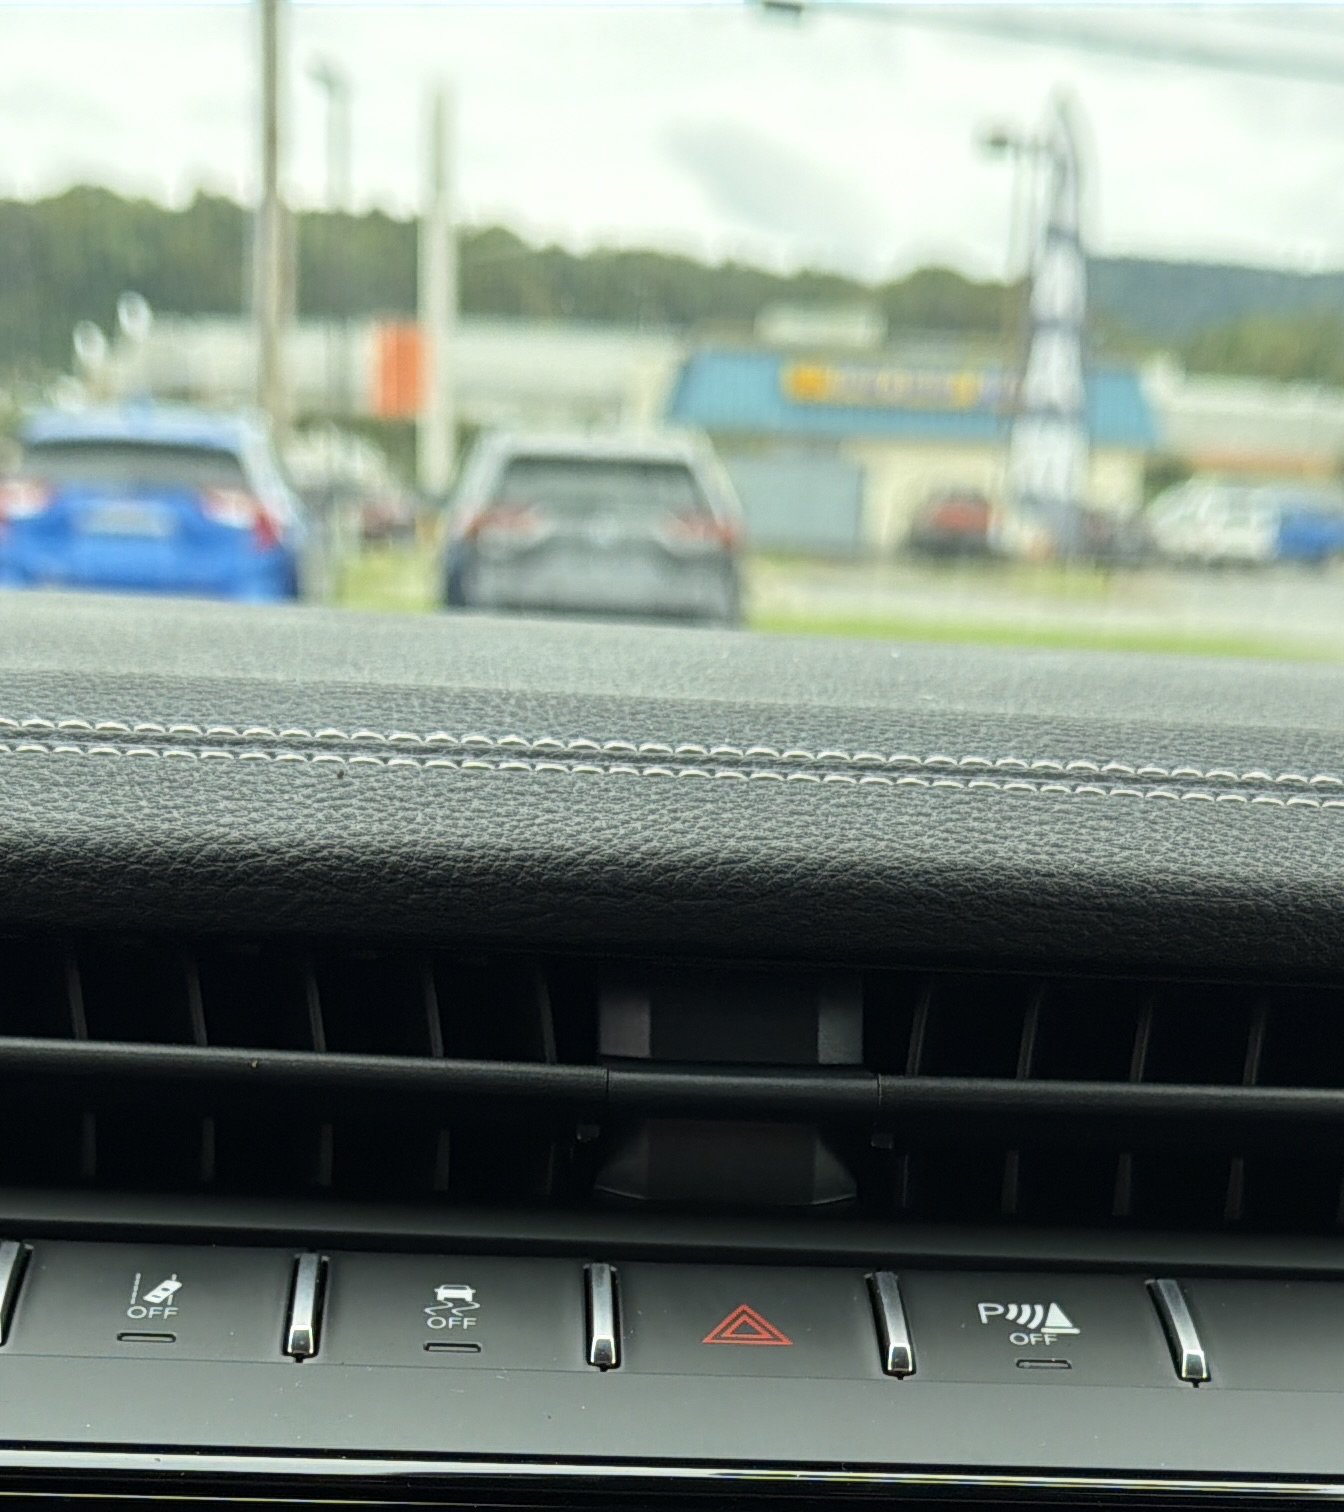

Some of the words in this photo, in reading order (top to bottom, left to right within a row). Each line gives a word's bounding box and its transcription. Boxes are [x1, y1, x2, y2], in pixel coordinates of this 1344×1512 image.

[126, 1305, 179, 1320] OFF
[977, 1302, 1005, 1325] P
[426, 1316, 478, 1330] OFF
[1008, 1332, 1058, 1346] OFF
